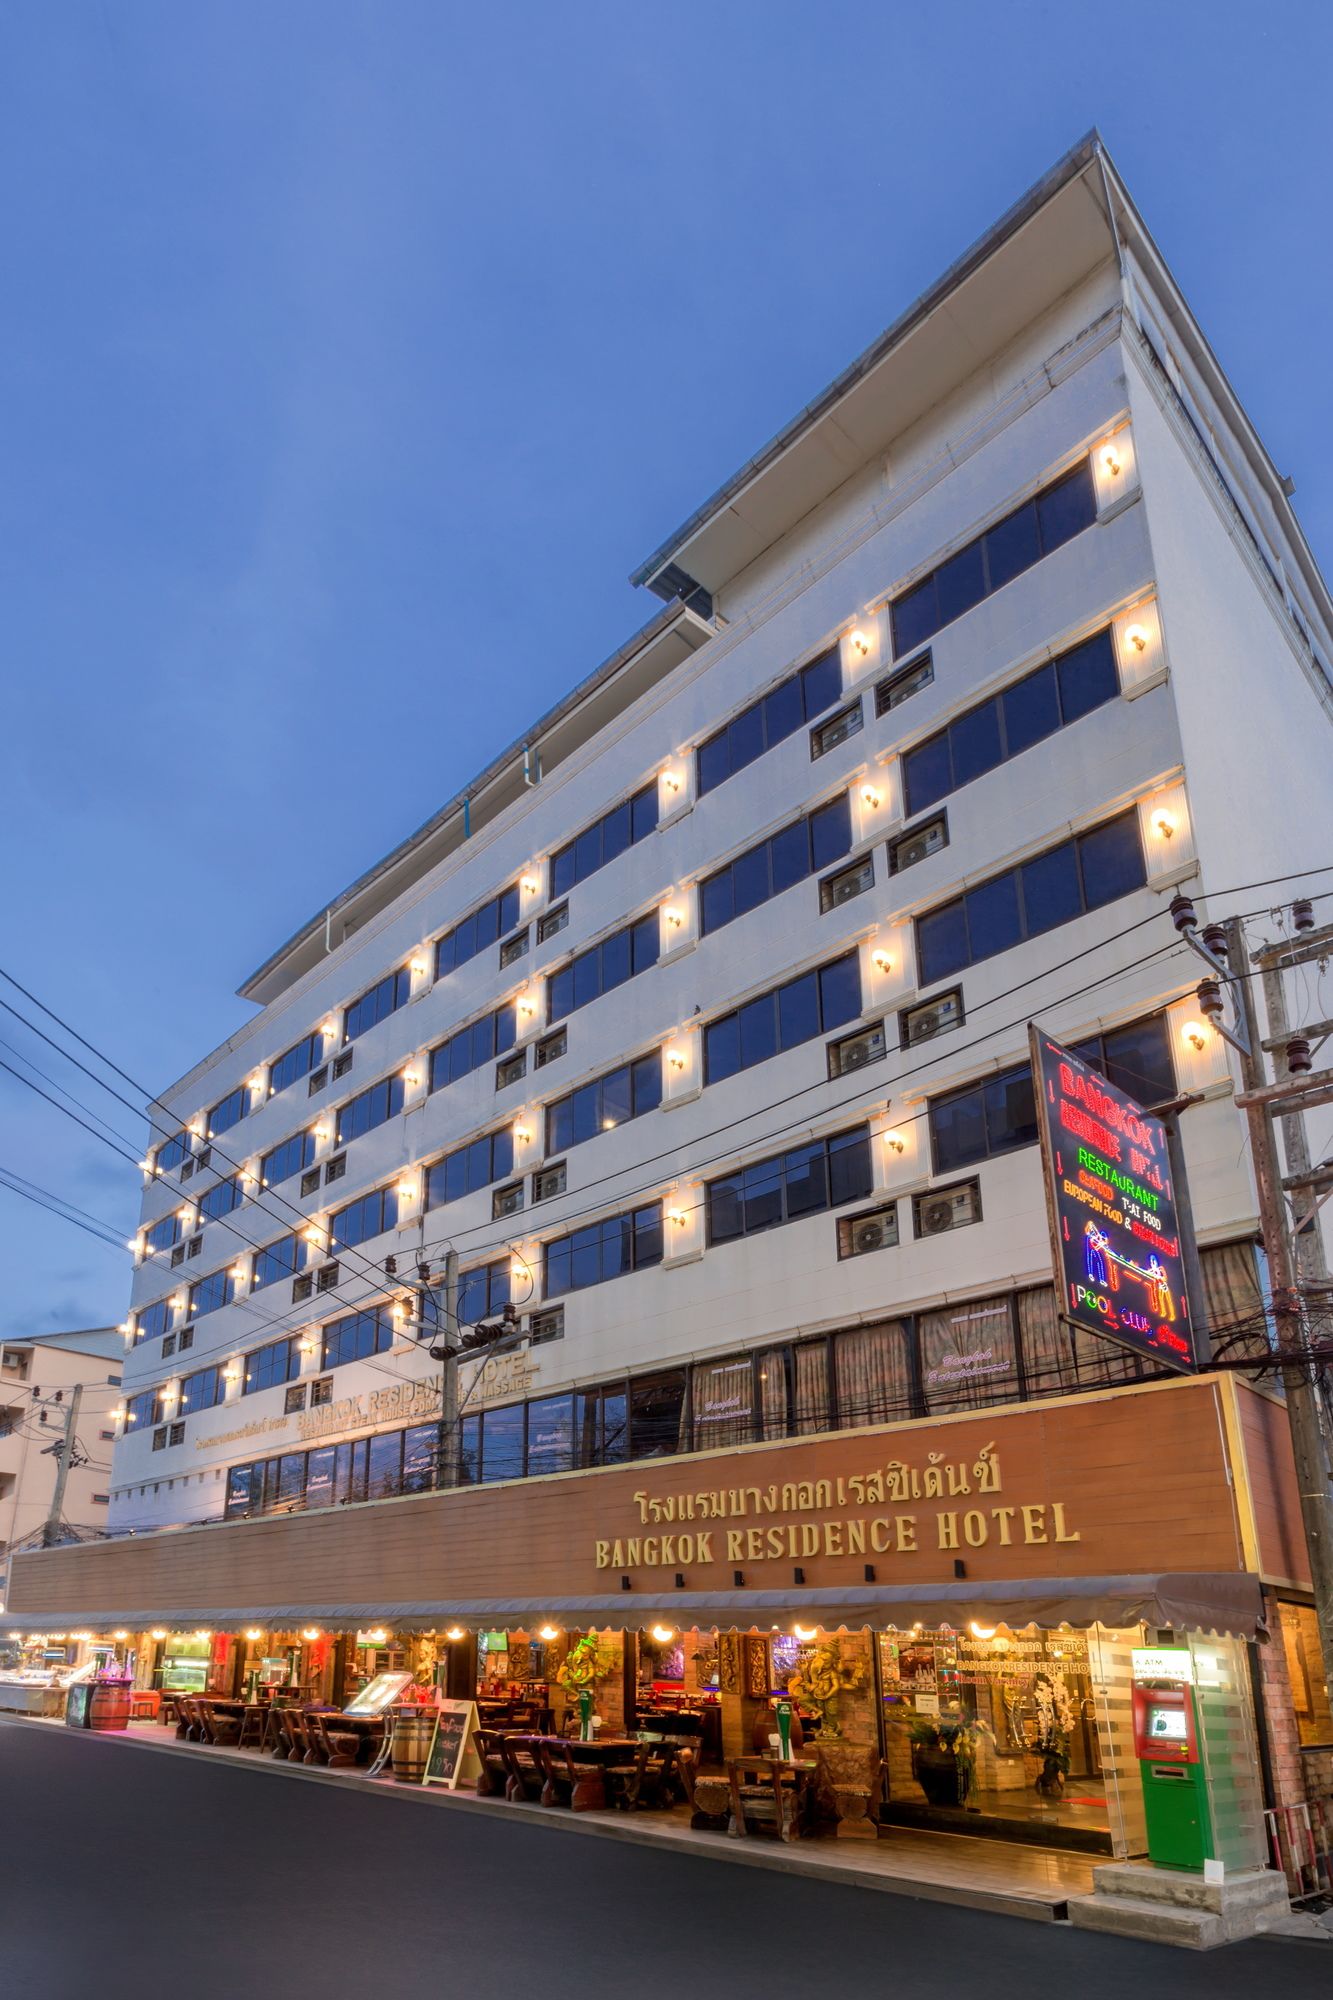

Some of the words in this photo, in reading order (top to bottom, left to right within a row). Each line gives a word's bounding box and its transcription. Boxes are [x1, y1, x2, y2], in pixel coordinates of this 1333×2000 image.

[1059, 1062, 1156, 1156] BANGKOK
[1078, 1147, 1159, 1212] RESTAURANT
[1124, 1217, 1132, 1231] &
[1143, 1211, 1162, 1231] FOOD
[1076, 1284, 1117, 1319] POOL
[594, 1531, 715, 1569] BANGKOK
[726, 1514, 918, 1562] RESIDENCE
[936, 1502, 1081, 1550] HOTEL
[956, 1660, 1007, 1672] BANGKOK
[1007, 1662, 1070, 1674] RESIDENCE
